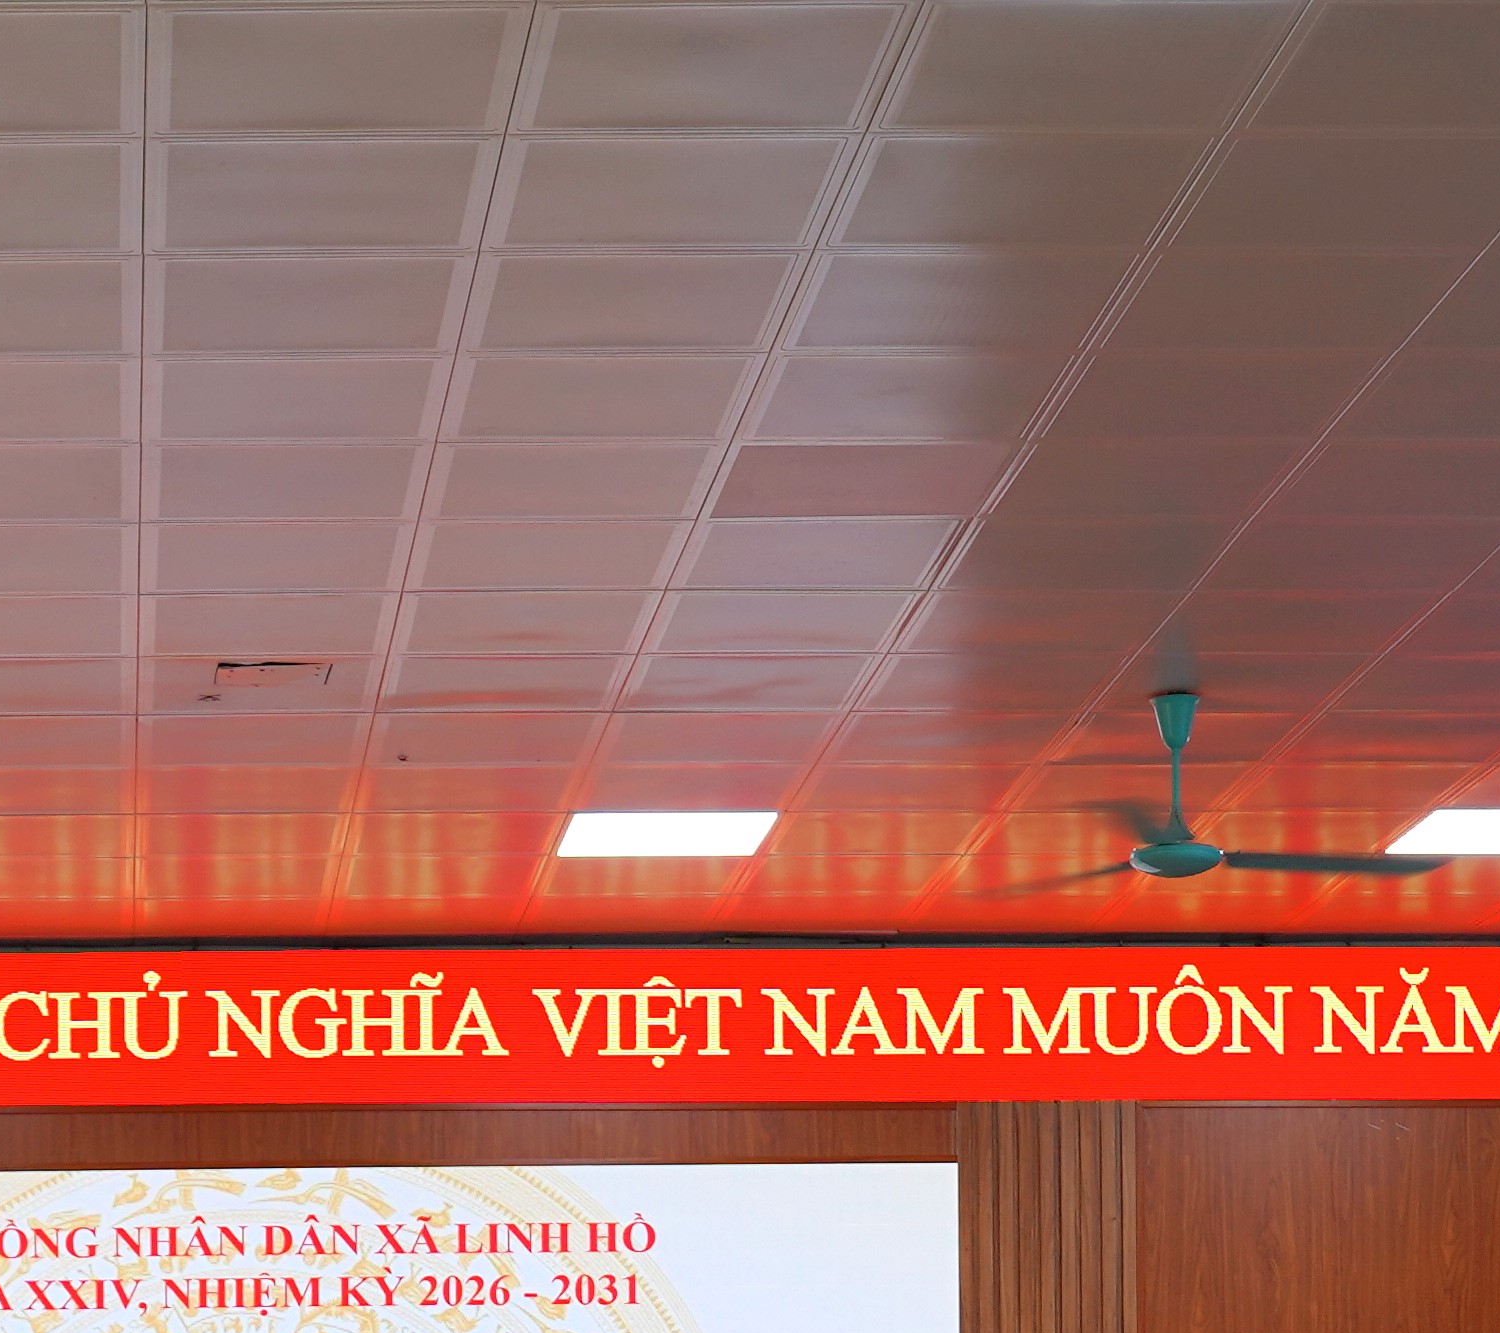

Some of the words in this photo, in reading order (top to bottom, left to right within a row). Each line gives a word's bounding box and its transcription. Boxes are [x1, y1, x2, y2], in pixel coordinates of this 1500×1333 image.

[205, 972, 509, 1058] NGHĨA
[532, 976, 742, 1068] VIỆT
[761, 987, 984, 1056] NAM
[1003, 965, 1292, 1055] MUÔN
[113, 1215, 247, 1257] NHÂN
[262, 1214, 359, 1255] DÂN
[375, 1216, 441, 1254] XÃ
[455, 1222, 571, 1254] LINH
[588, 1213, 656, 1253] HỒ
[25, 1279, 149, 1317] XXIV,
[162, 1273, 321, 1316] NHIỆM
[340, 1267, 403, 1307] KỲ
[419, 1275, 510, 1305] 2026
[552, 1273, 640, 1305] 2031
